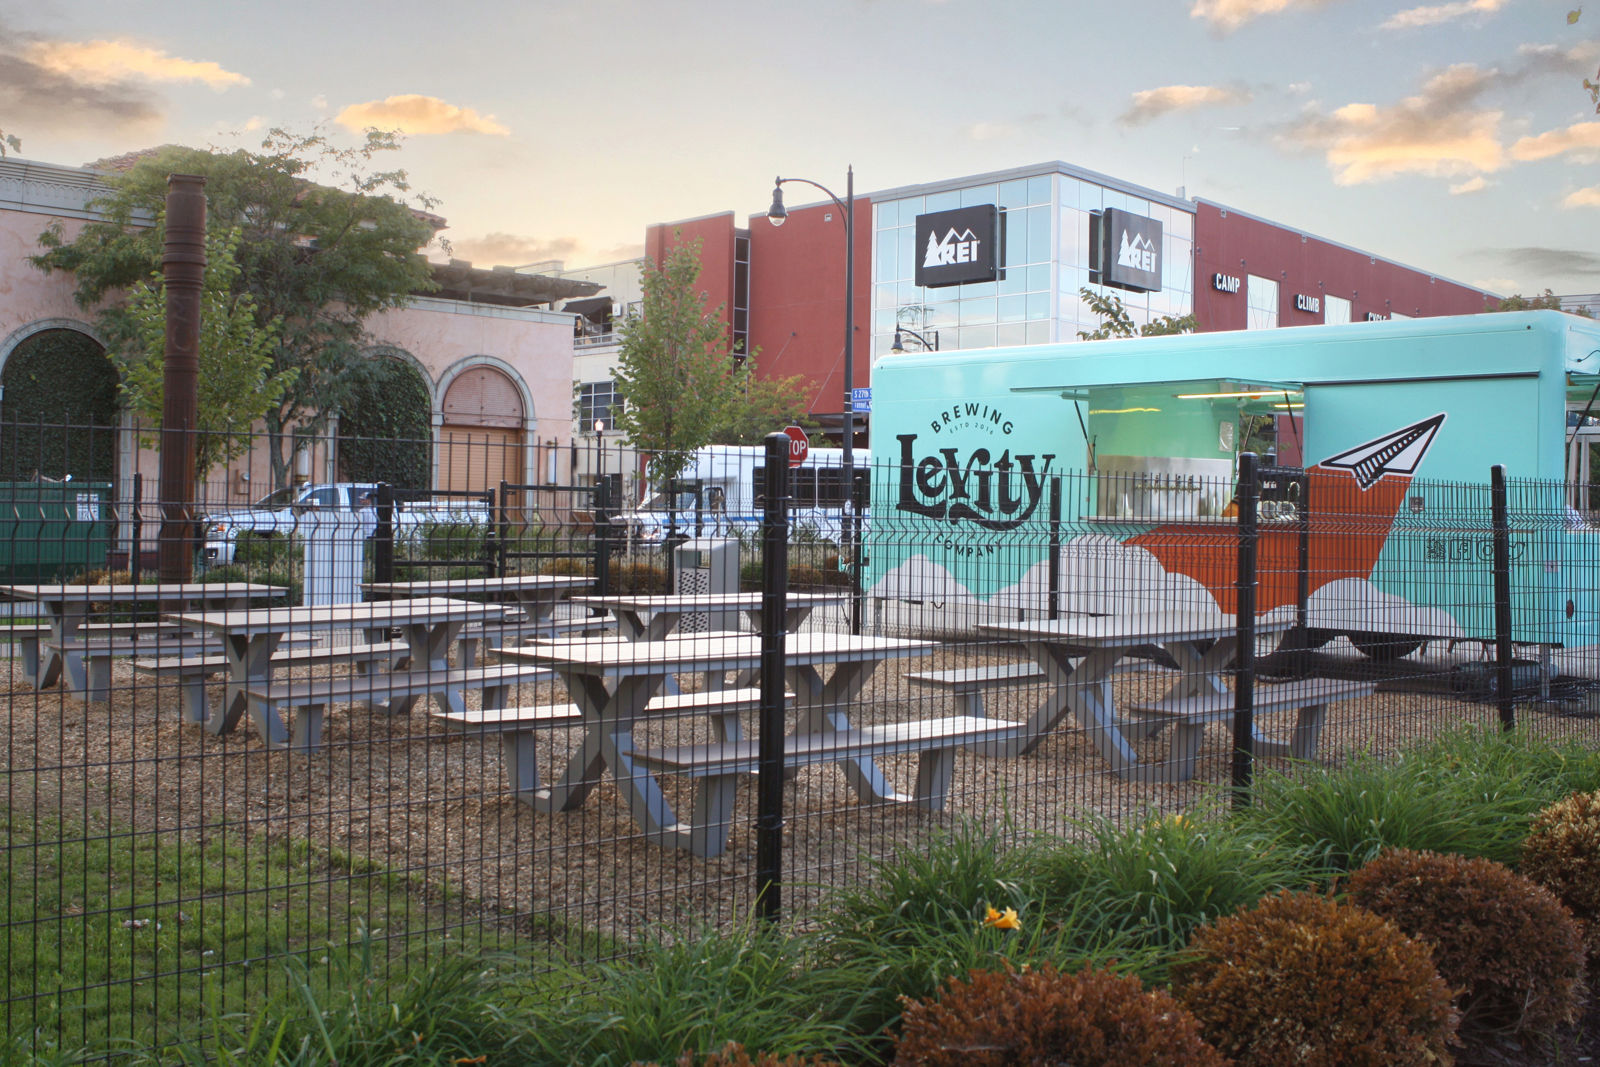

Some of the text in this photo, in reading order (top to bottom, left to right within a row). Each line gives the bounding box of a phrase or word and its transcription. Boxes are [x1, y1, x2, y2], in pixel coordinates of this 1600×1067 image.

[940, 240, 978, 265] REI
[1130, 248, 1156, 273] REI
[1216, 273, 1240, 293] CAMP
[1297, 294, 1320, 313] CLIMB
[931, 403, 1014, 435] BREWING
[788, 440, 806, 455] TOP
[896, 434, 1056, 531] Levity
